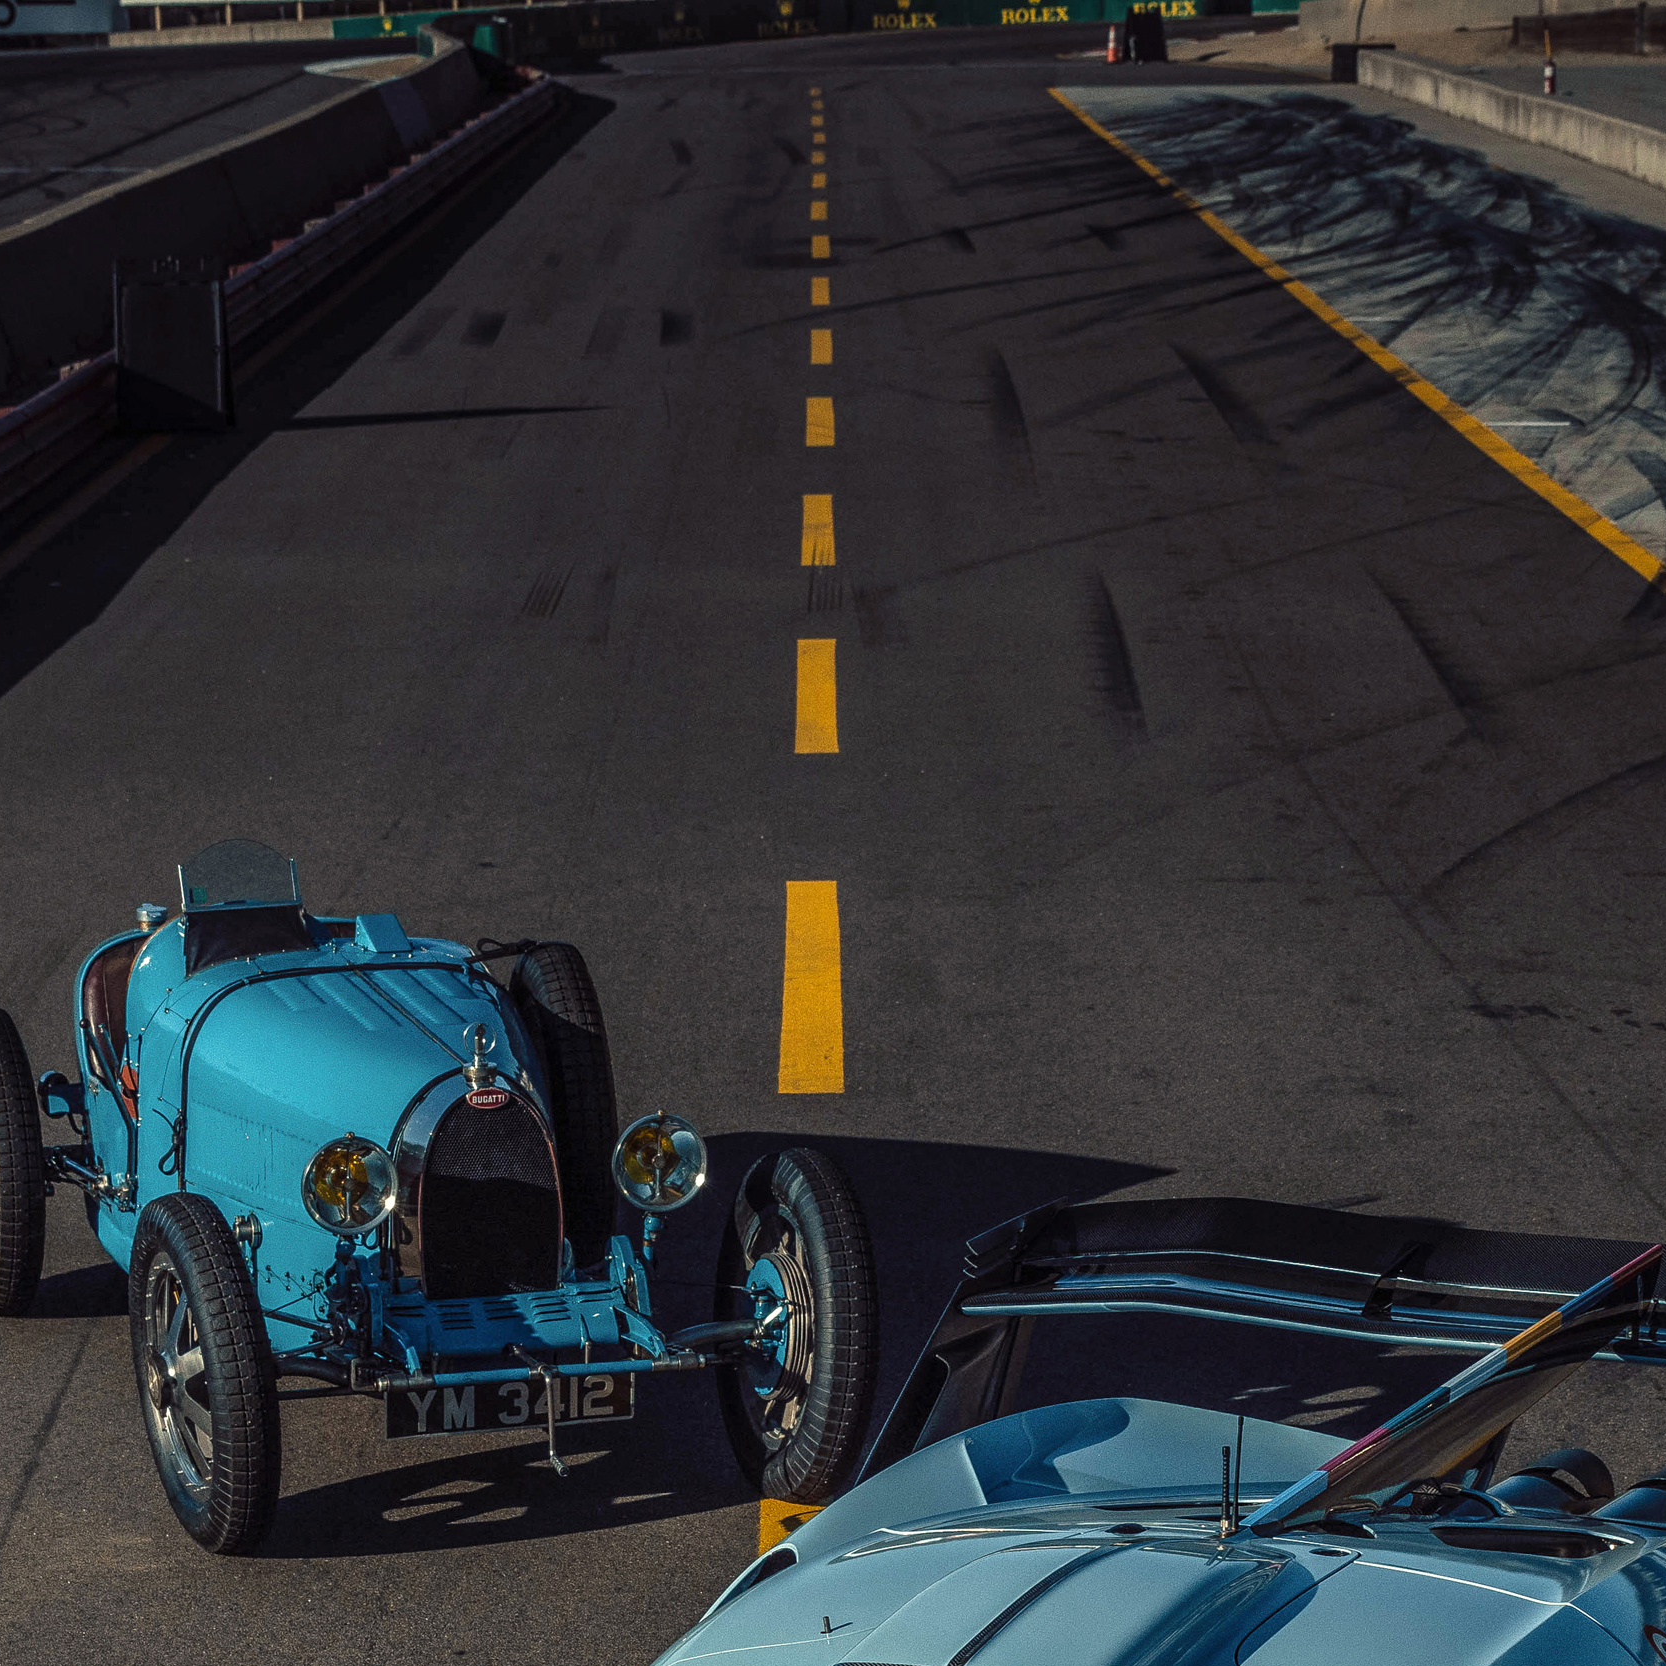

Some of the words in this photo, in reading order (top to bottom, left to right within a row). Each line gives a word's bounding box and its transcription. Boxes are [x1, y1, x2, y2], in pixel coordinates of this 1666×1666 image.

[873, 12, 937, 30] ROLEX
[1001, 6, 1070, 25] ROLEX
[472, 1094, 505, 1104] BUGATTI
[407, 1385, 476, 1433] YM
[498, 1374, 615, 1425] 3412
